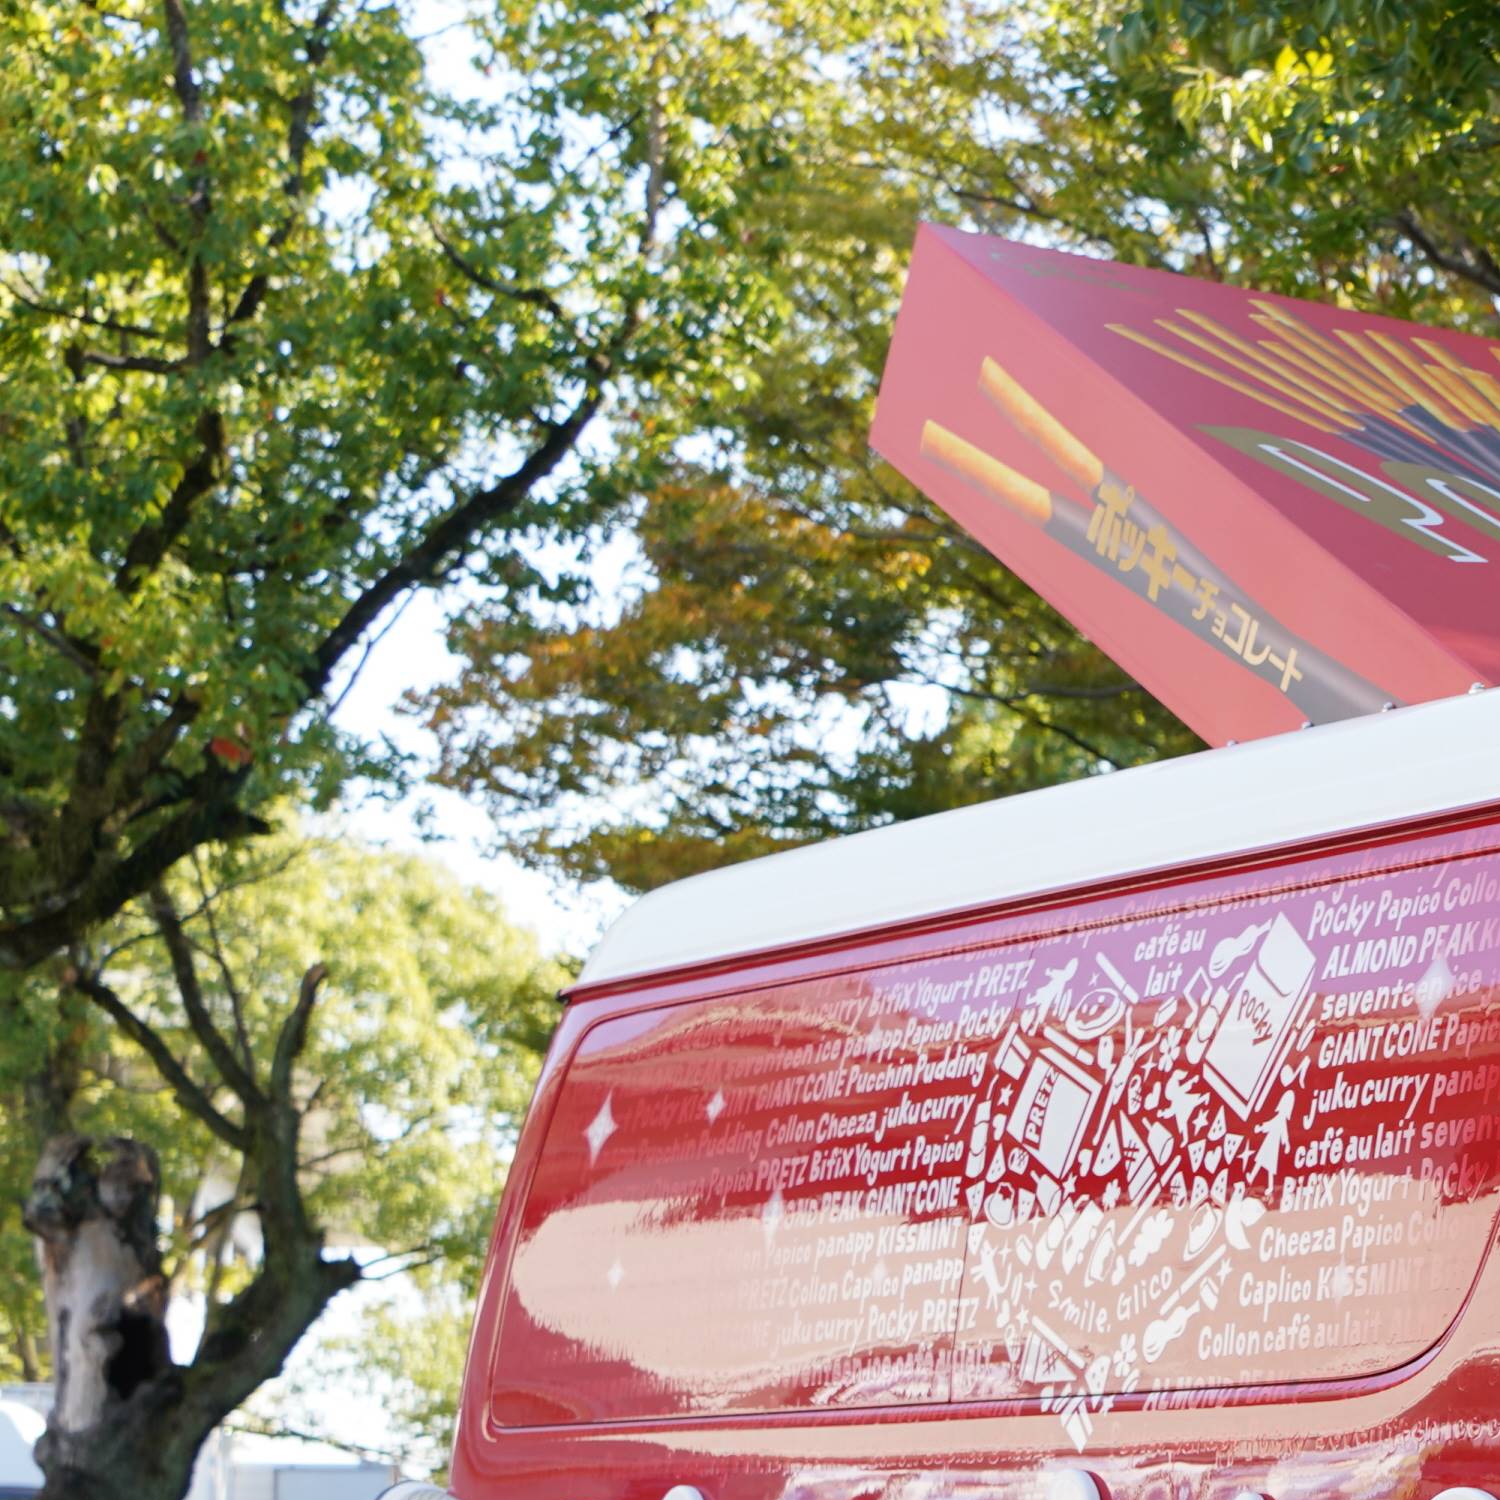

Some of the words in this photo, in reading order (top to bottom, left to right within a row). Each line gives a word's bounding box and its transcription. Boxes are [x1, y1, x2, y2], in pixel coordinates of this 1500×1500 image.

[1086, 483, 1304, 693] ポッキーチョコレート
[1307, 893, 1376, 941] Pocky
[1374, 886, 1441, 931] Papico
[1134, 922, 1180, 963] café
[1180, 928, 1207, 955] au
[1321, 934, 1418, 980] ALMOND
[1417, 920, 1480, 963] PEAK
[914, 973, 975, 1021] Yogurt
[972, 958, 1036, 999] PRETZ
[1144, 961, 1183, 998] lait
[902, 1016, 952, 1057] Papico
[953, 1002, 1012, 1042] Pocky
[815, 1109, 877, 1144] Cheeza
[920, 1091, 977, 1135] curry
[1025, 1070, 1061, 1144] PRETZ
[1360, 1071, 1430, 1120] curry
[755, 1156, 810, 1192] PRETZ
[854, 1140, 912, 1186] Yogurt
[911, 1135, 965, 1177] Papico
[1293, 1126, 1346, 1169] café
[1344, 1128, 1377, 1164] au
[1373, 1119, 1416, 1159] lait
[1338, 1165, 1413, 1217] Yogurt
[876, 1217, 963, 1256] KISSMINT
[1258, 1225, 1337, 1263] Cheeza
[1337, 1214, 1403, 1265] Papico
[901, 1257, 965, 1299] panapp
[1115, 1264, 1174, 1322] Glico
[1238, 1266, 1313, 1323] Caplico
[1314, 1256, 1427, 1303] KSSMINT
[866, 1302, 919, 1346] Pocky
[920, 1297, 981, 1334] PRETZ
[1196, 1321, 1262, 1362] Collon
[1262, 1311, 1312, 1353] café
